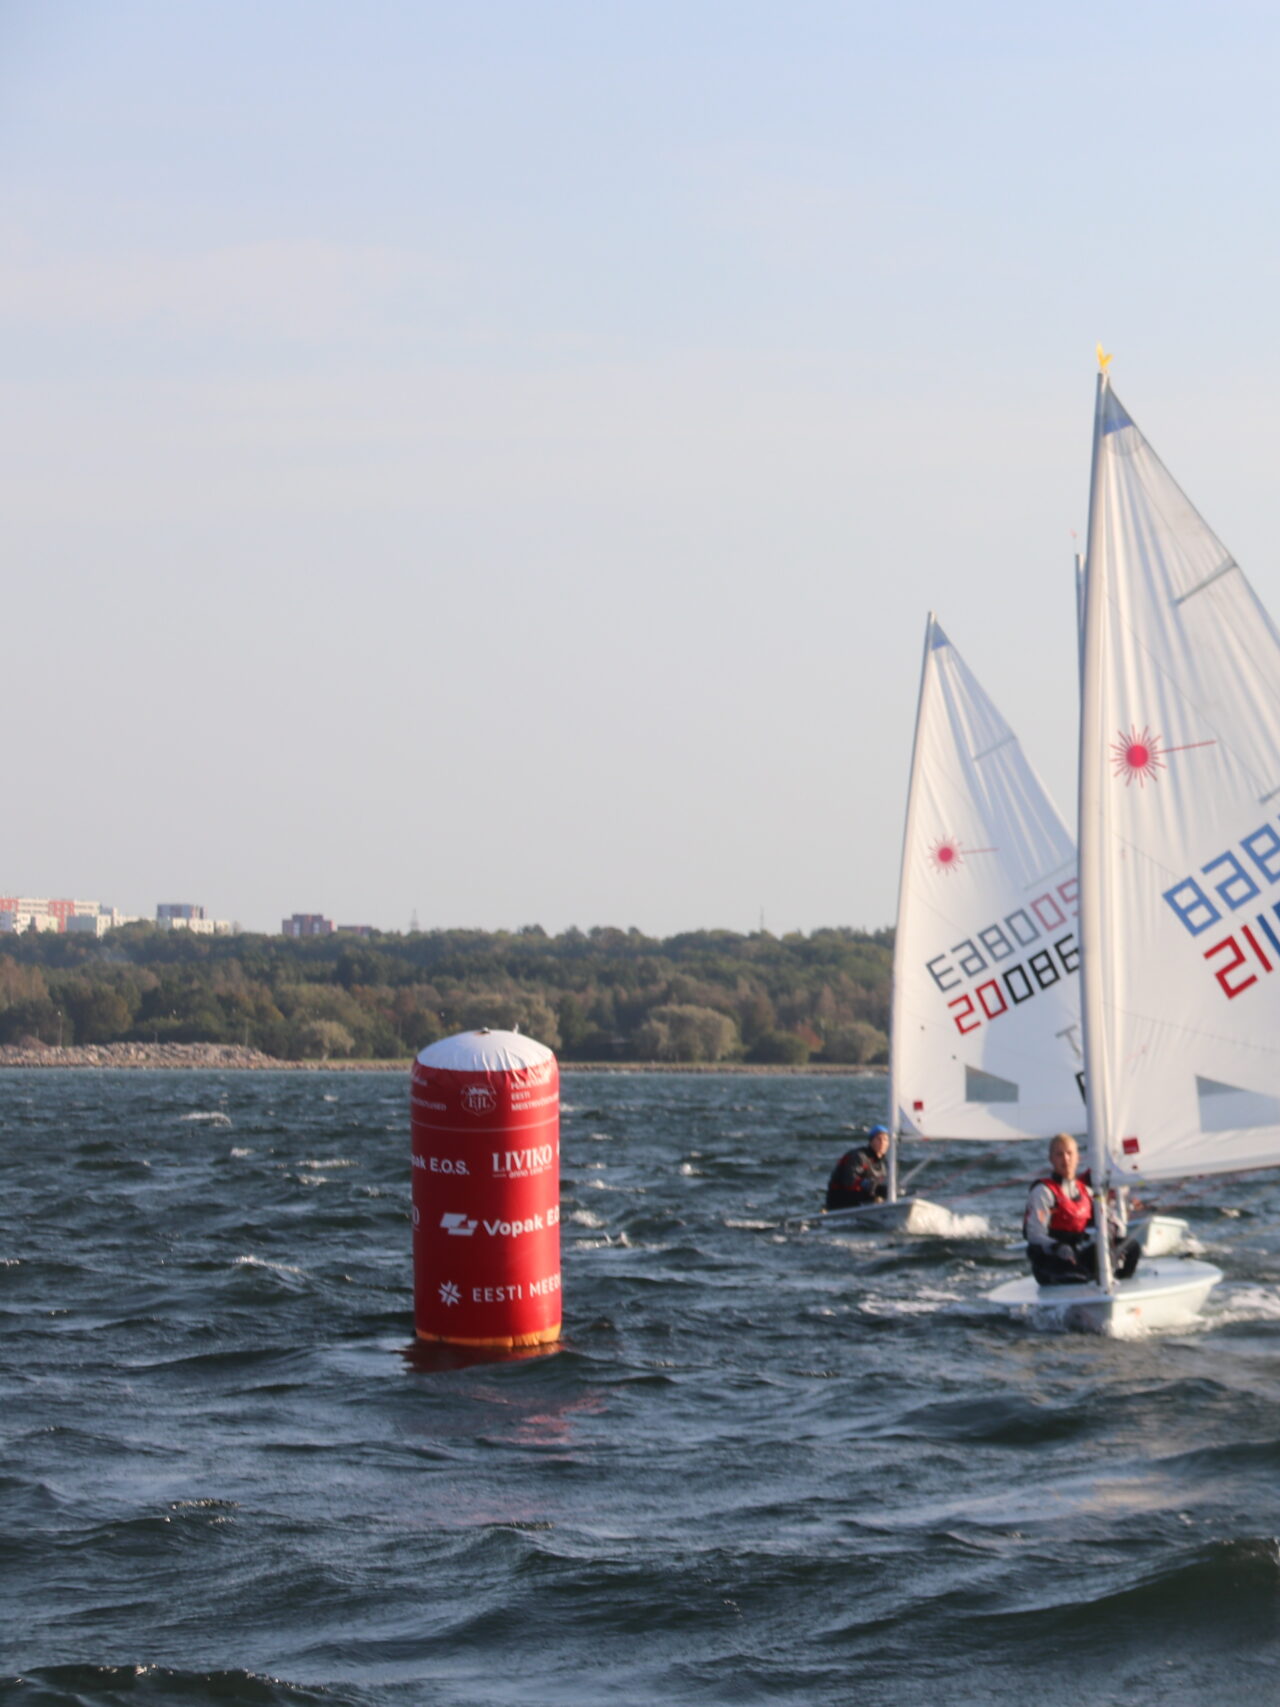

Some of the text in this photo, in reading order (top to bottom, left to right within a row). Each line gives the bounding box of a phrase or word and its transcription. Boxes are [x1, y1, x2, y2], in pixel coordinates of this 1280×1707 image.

[492, 1144, 553, 1172] LIVIKO
[482, 1212, 543, 1238] Vopak
[472, 1284, 522, 1303] EESTI
